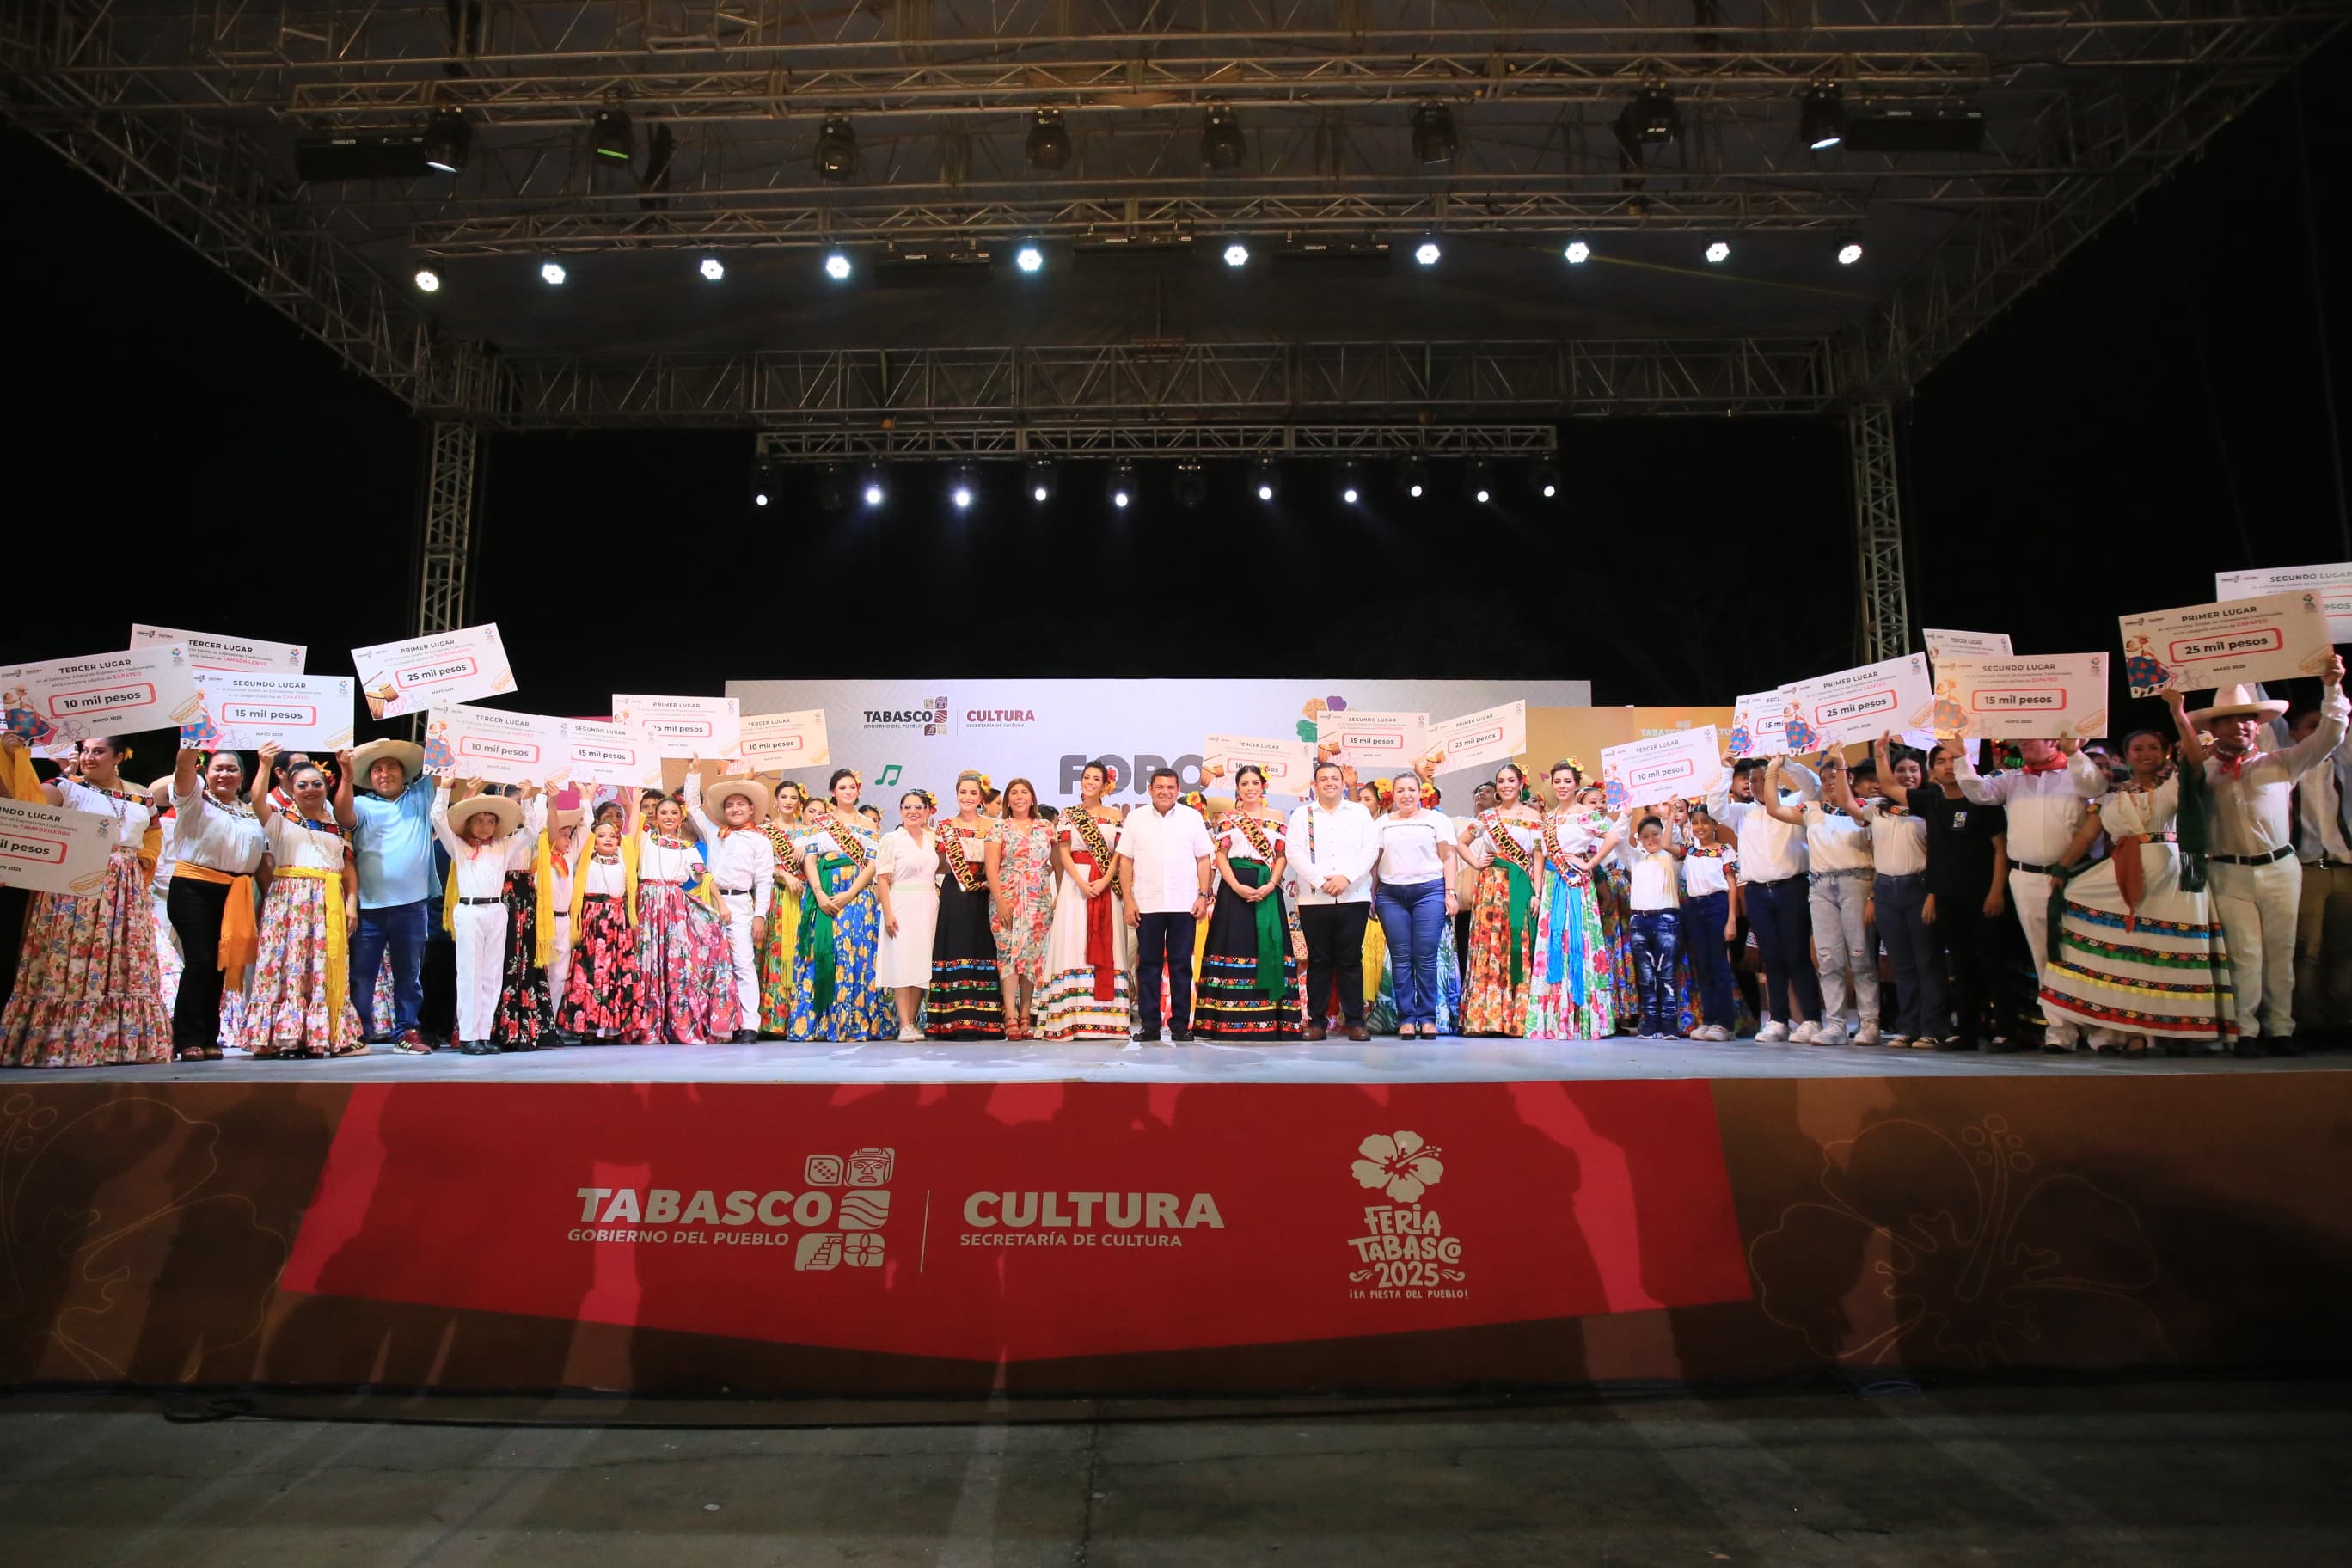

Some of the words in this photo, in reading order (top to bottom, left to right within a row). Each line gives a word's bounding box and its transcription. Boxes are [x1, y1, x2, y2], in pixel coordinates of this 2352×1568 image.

[2269, 573, 2317, 583] SEGUNDO
[2182, 611, 2220, 622] PRIMER
[2223, 605, 2257, 616] LUGAR
[2324, 603, 2351, 611] esos
[187, 639, 223, 651] TERCER
[224, 643, 254, 653] LUGAR
[401, 644, 429, 654] PRIMER
[430, 639, 456, 649] LUGAR
[2185, 645, 2201, 655] 25
[2204, 641, 2225, 653] mil
[2228, 637, 2269, 650] pesos
[58, 663, 98, 674] TERCER
[99, 659, 132, 670] LUGAR
[407, 673, 420, 682] 25
[421, 669, 437, 679] mil
[439, 665, 467, 677] pesos
[1823, 677, 1852, 689] PRIMER
[1853, 671, 1878, 682] LUGAR
[64, 699, 78, 709] 10
[82, 695, 101, 706] mil
[105, 691, 141, 705] pesos
[1985, 696, 1995, 705] 15
[1999, 695, 2016, 704] mil
[2019, 695, 2053, 706] pesos
[249, 709, 267, 718] mil
[270, 710, 303, 720] pesos
[1827, 708, 1838, 717] 25
[1840, 704, 1855, 714] mil
[1858, 698, 1887, 711] pesos
[475, 714, 504, 724] TERCER
[505, 719, 530, 727] LUGAR
[863, 710, 933, 723] TABASCO
[966, 709, 1036, 723] CULTURA
[574, 725, 605, 733] SEGUNDO
[1476, 733, 1497, 743] pesos
[483, 744, 499, 754] mil
[501, 747, 530, 757] pesos
[1636, 744, 1658, 753] TERCER
[1659, 739, 1679, 749] LUGAR
[1648, 769, 1660, 778] mil
[1662, 766, 1685, 777] pesos
[28, 811, 61, 823] LUGAR
[20, 824, 70, 837] TAMBORILEROS
[11, 842, 50, 855] pesos
[1080, 820, 1112, 868] TABASCO
[576, 1188, 832, 1227] TABASCO
[963, 1191, 1224, 1228] CULTURA
[567, 1228, 668, 1243] GOBIERNO
[673, 1231, 708, 1245] DEL
[714, 1231, 789, 1246] PUEBLO
[960, 1231, 1067, 1246] SECRETARÍA
[1073, 1234, 1097, 1246] DE
[1101, 1234, 1182, 1246] CULTURA
[1375, 1261, 1440, 1288] 2025
[1370, 1290, 1401, 1299] FIESTA
[1406, 1290, 1423, 1299] DEL
[1428, 1290, 1468, 1299] PUEBLO!
